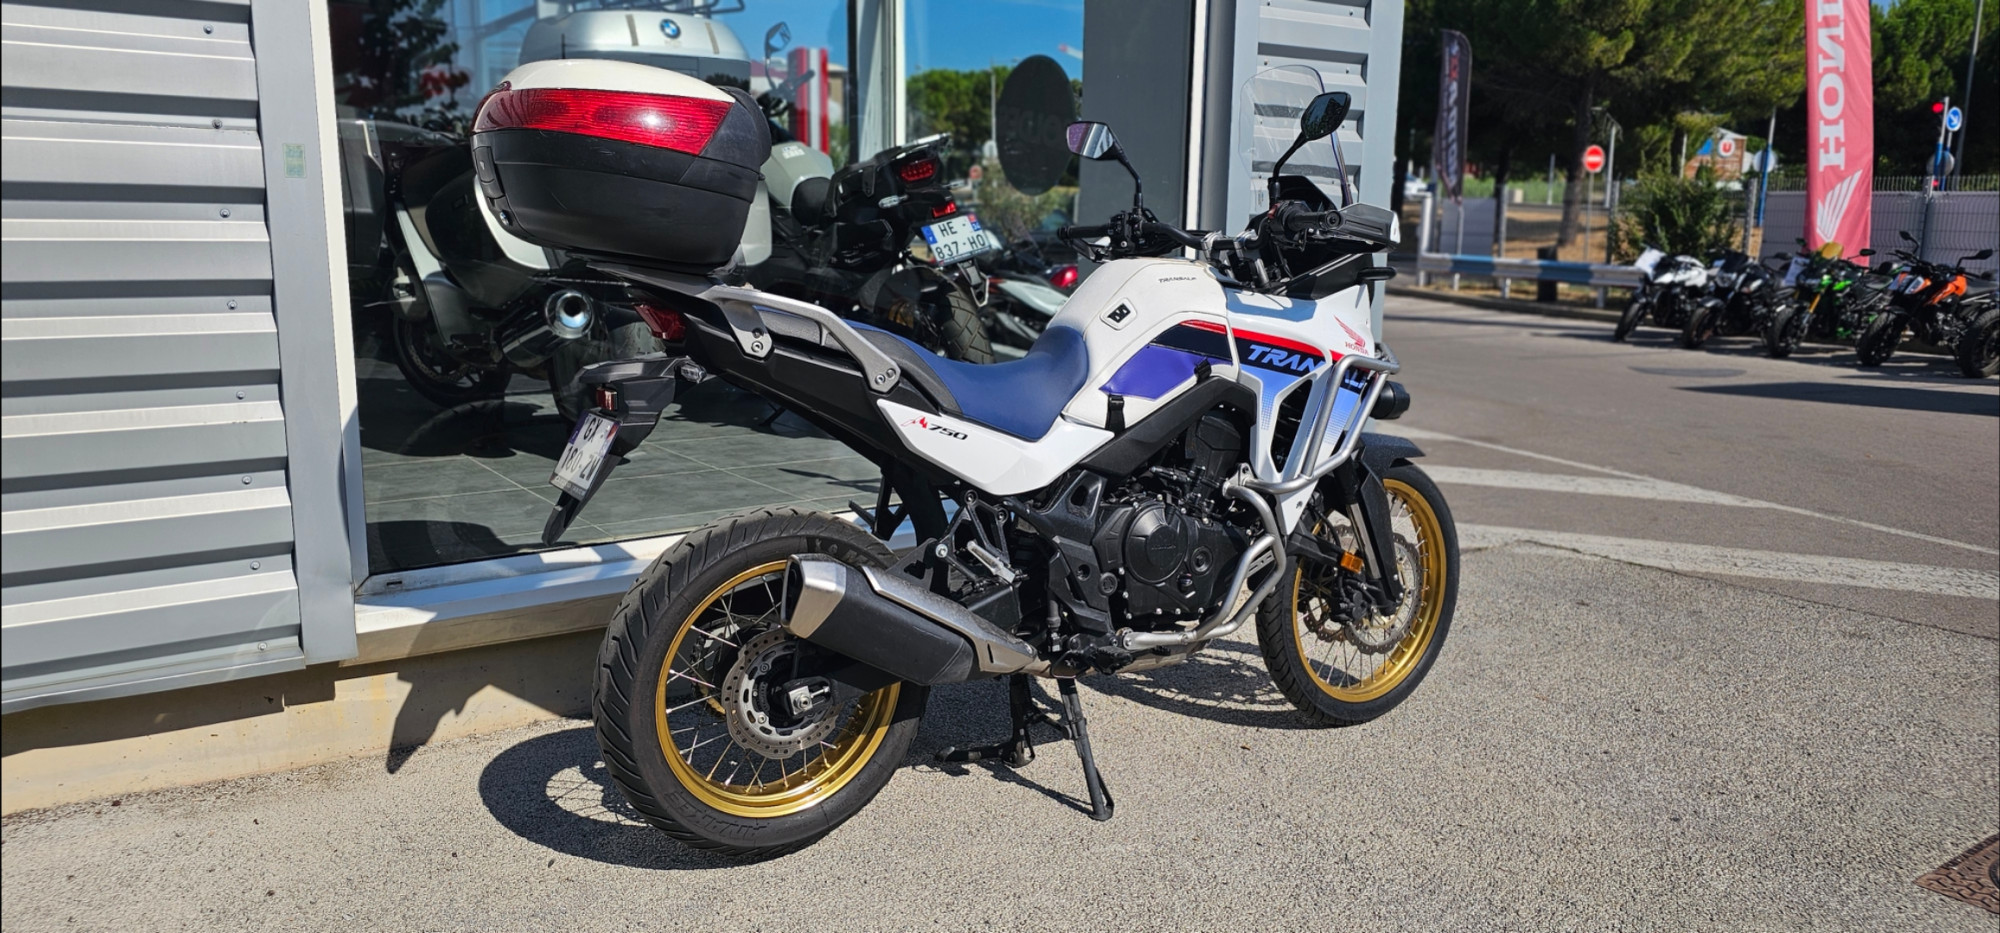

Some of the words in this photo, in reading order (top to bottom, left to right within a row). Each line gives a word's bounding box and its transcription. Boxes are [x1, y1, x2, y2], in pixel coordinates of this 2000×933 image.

[937, 221, 958, 237] HE
[583, 417, 604, 443] GX
[928, 423, 968, 440] 750
